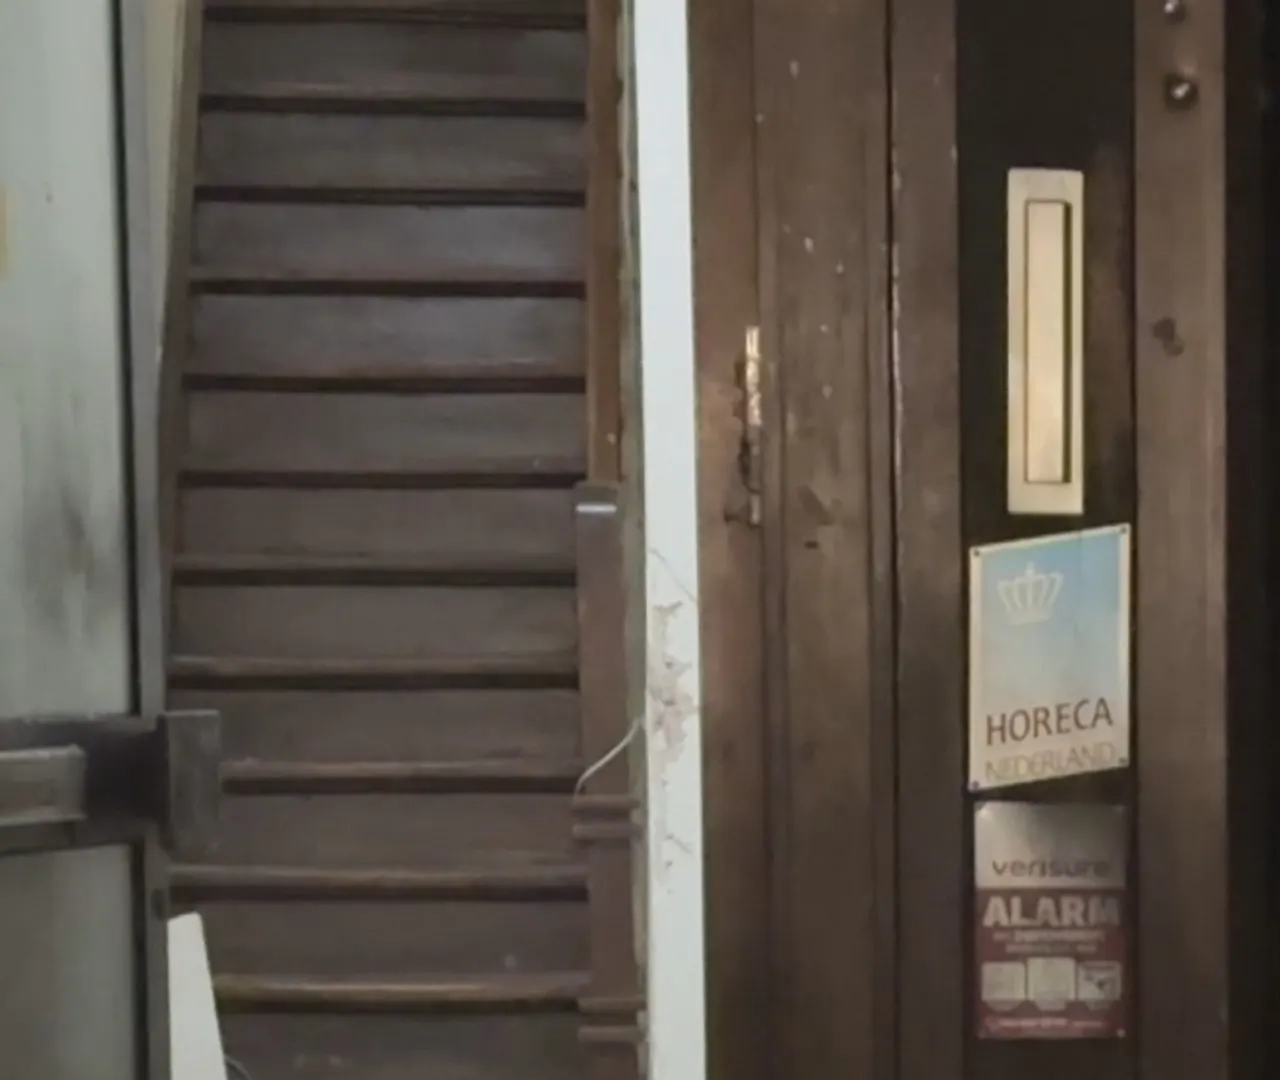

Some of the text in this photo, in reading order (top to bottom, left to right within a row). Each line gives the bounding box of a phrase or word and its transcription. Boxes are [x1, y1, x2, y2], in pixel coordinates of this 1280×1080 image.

[985, 697, 1113, 746] HORECA
[985, 741, 1117, 782] NEDERLAND
[992, 858, 1110, 878] verisure
[982, 895, 1121, 928] ALARM
